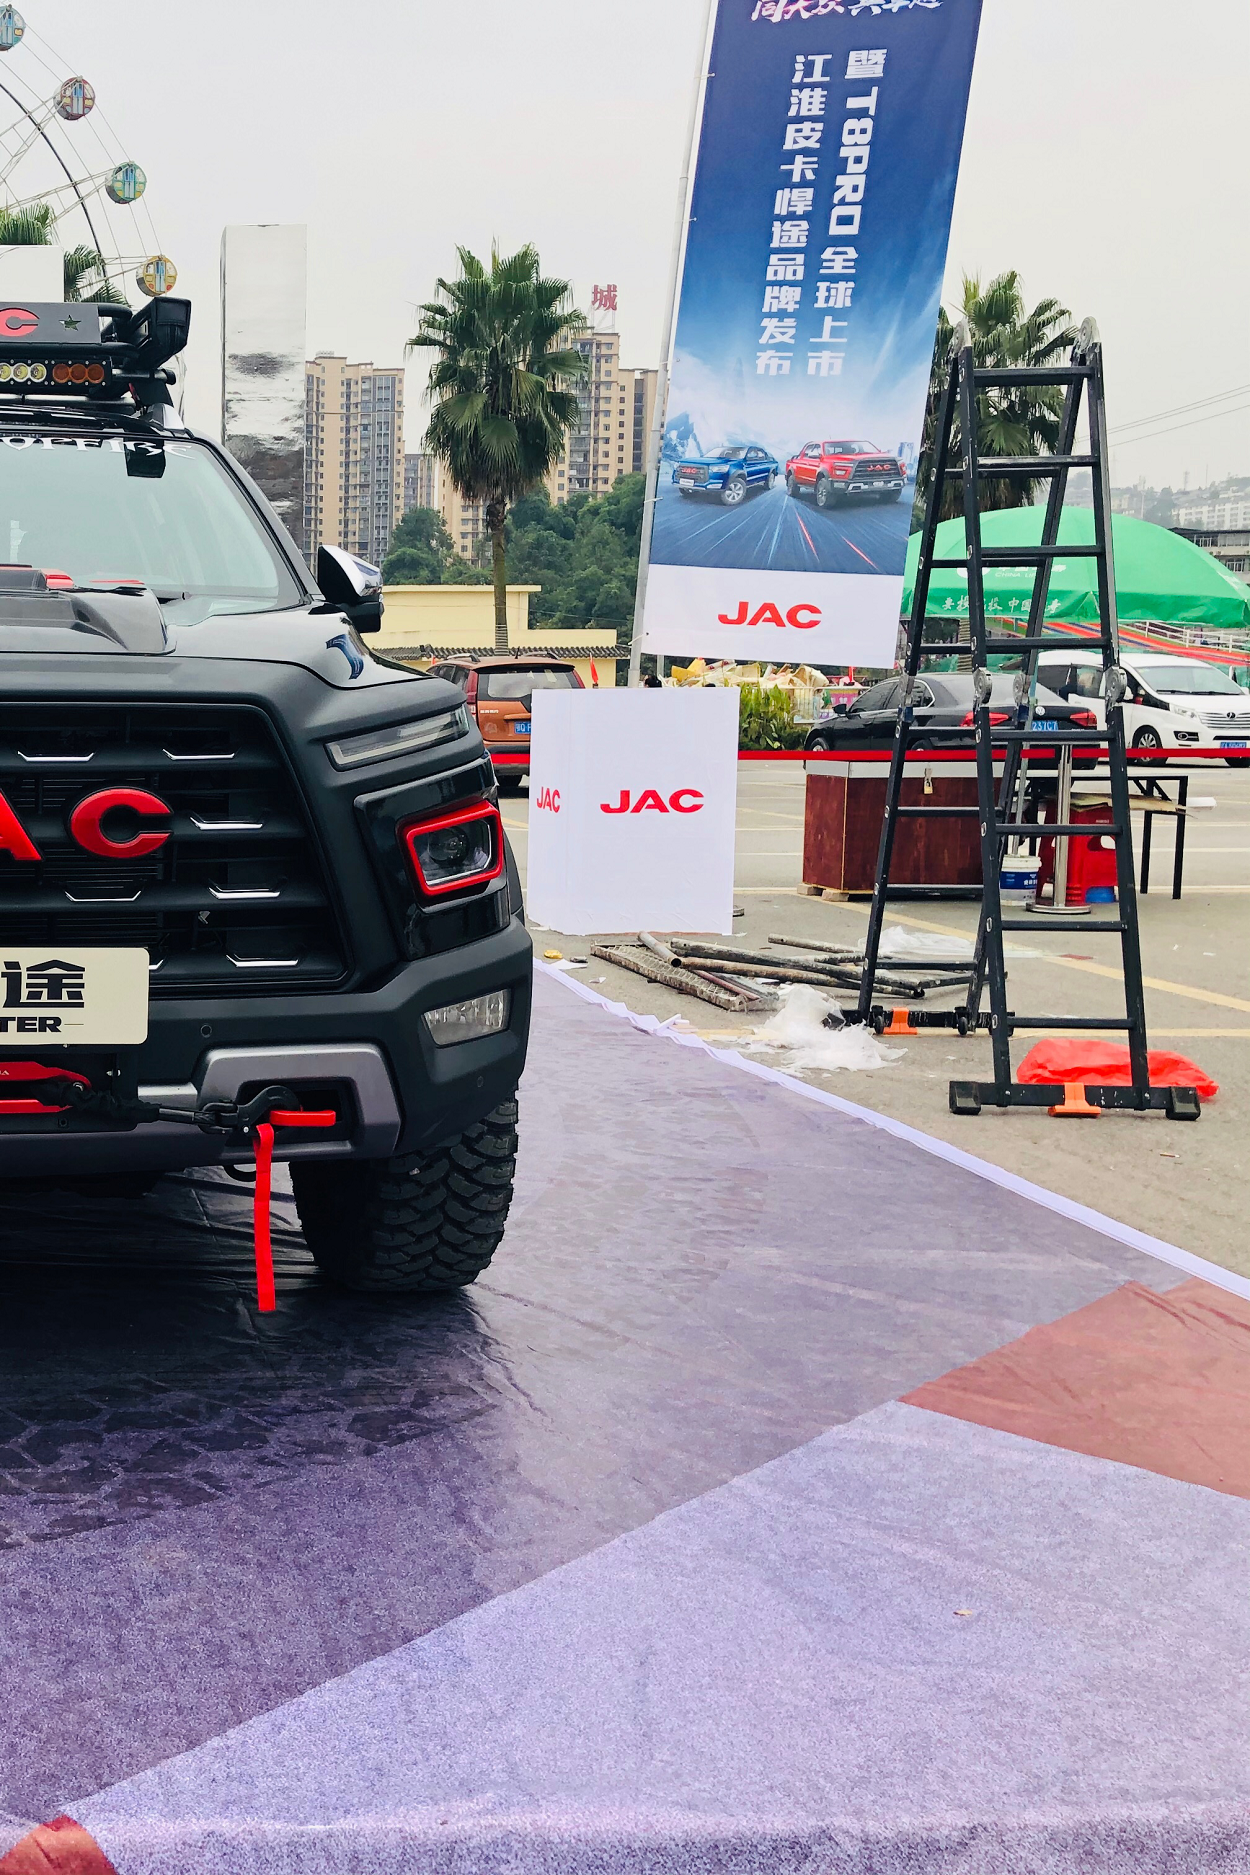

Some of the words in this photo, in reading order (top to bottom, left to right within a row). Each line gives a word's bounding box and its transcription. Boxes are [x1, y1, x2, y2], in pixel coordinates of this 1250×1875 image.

[756, 53, 833, 377] 江淮皮卡悍途品牌发布
[591, 284, 618, 311] 城
[717, 601, 823, 629] JAC
[536, 786, 561, 813] JAC
[599, 788, 705, 814] JAC
